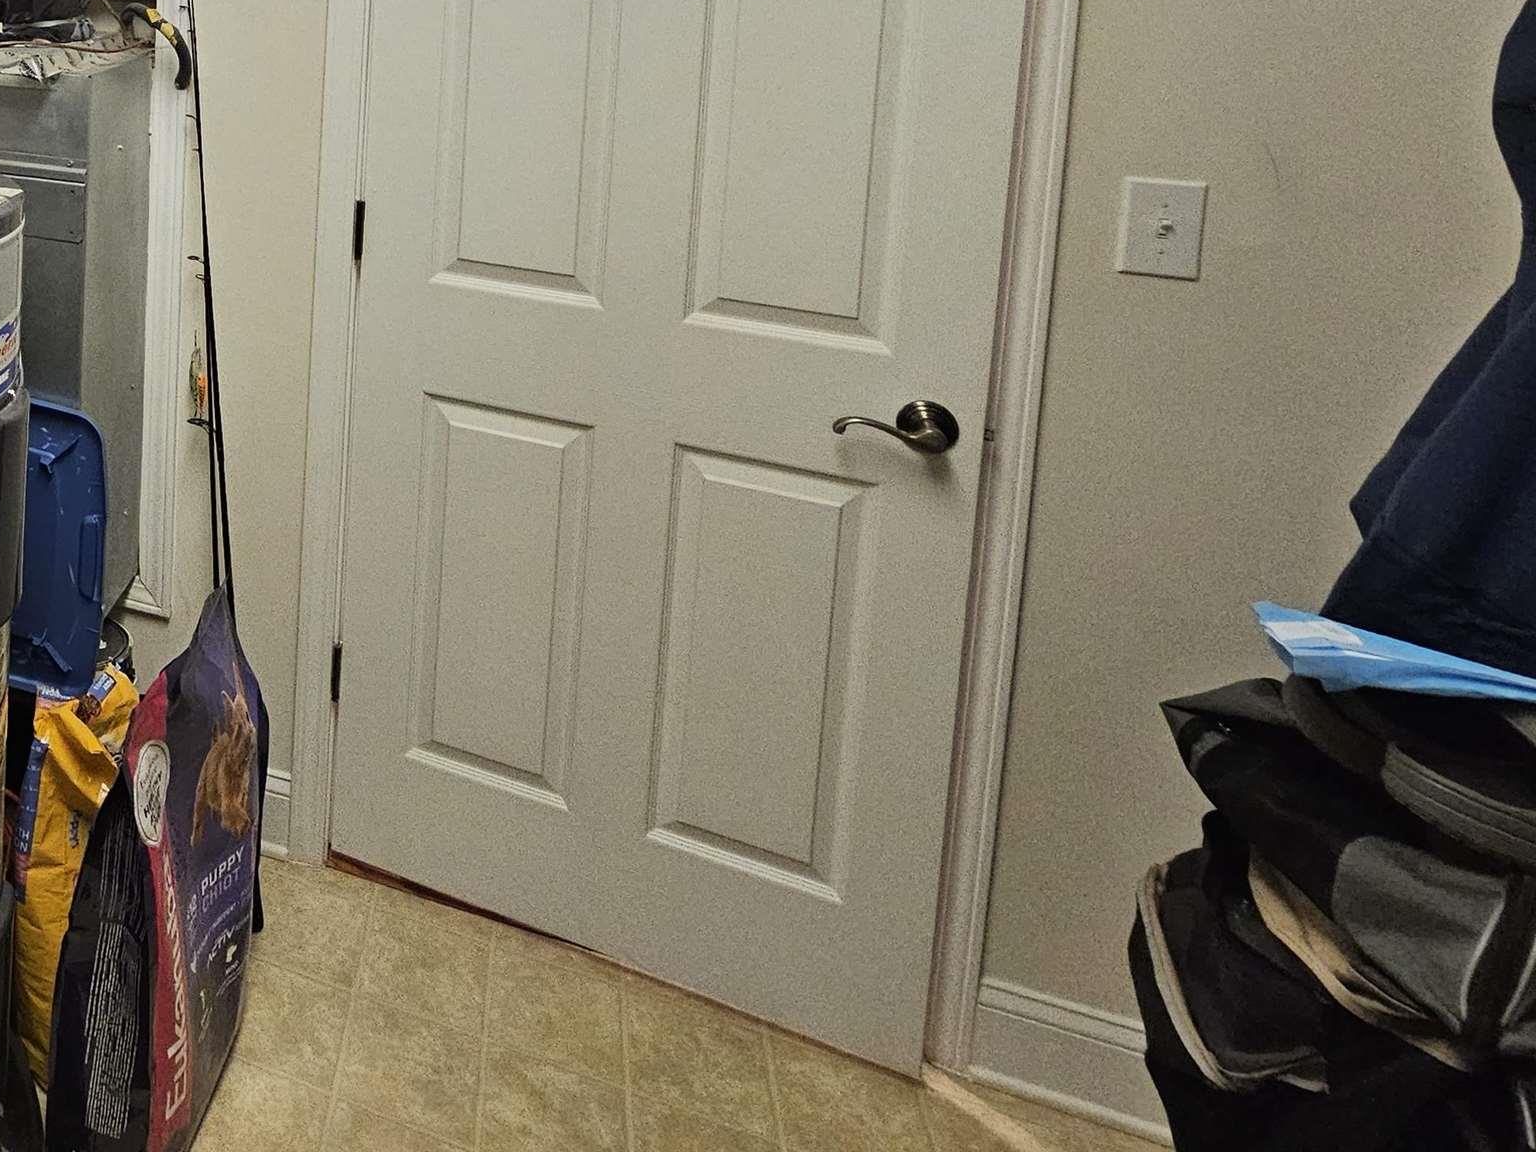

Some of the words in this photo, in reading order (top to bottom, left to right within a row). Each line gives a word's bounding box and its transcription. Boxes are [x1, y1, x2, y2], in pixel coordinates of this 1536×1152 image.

[201, 846, 244, 895] PUPPY
[202, 867, 240, 913] CHIOT
[164, 850, 189, 1121] Eukanuba
